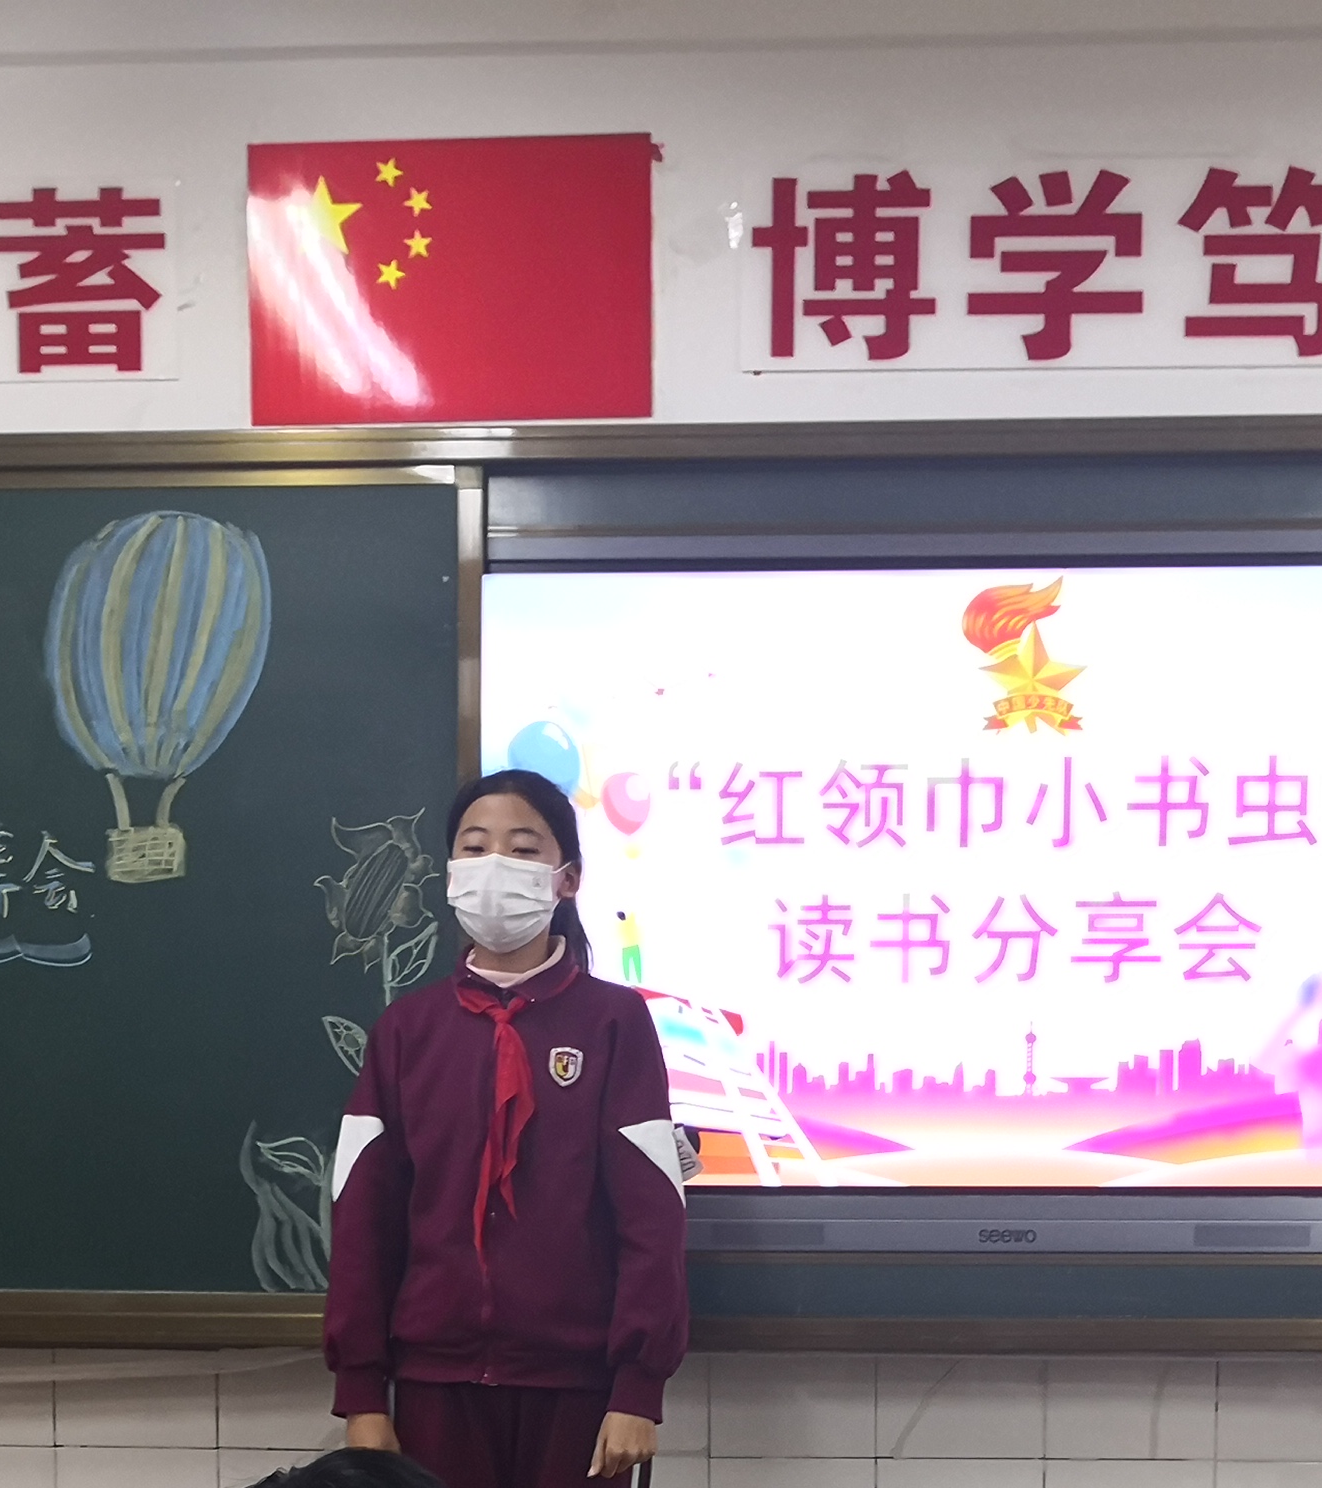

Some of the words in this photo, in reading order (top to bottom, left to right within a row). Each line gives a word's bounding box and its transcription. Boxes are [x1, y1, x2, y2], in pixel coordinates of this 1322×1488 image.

[767, 891, 1264, 985] 读书分享会
[978, 1228, 1038, 1244] seewo
